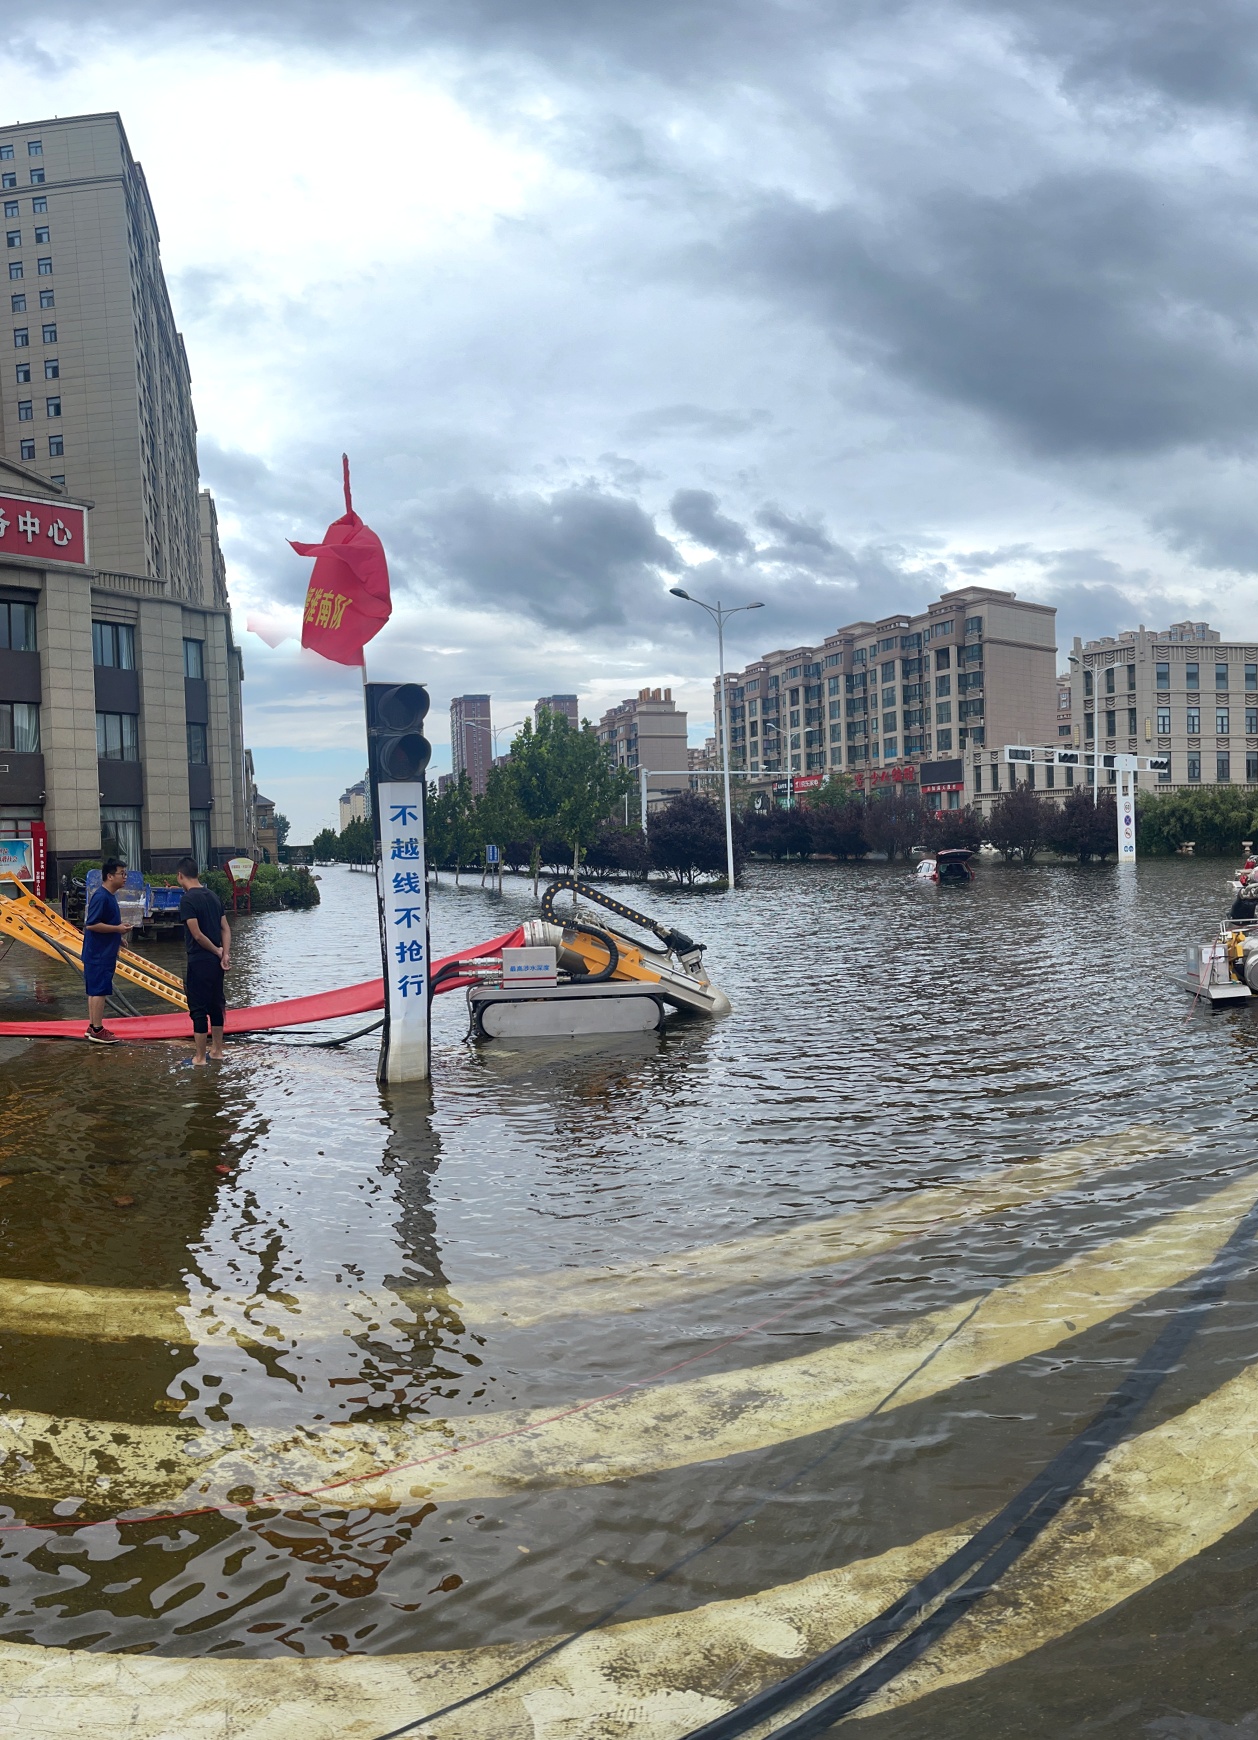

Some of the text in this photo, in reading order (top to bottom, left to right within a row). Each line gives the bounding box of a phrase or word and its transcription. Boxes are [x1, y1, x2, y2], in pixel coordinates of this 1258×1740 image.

[389, 805, 425, 998] 不越线不抢行
